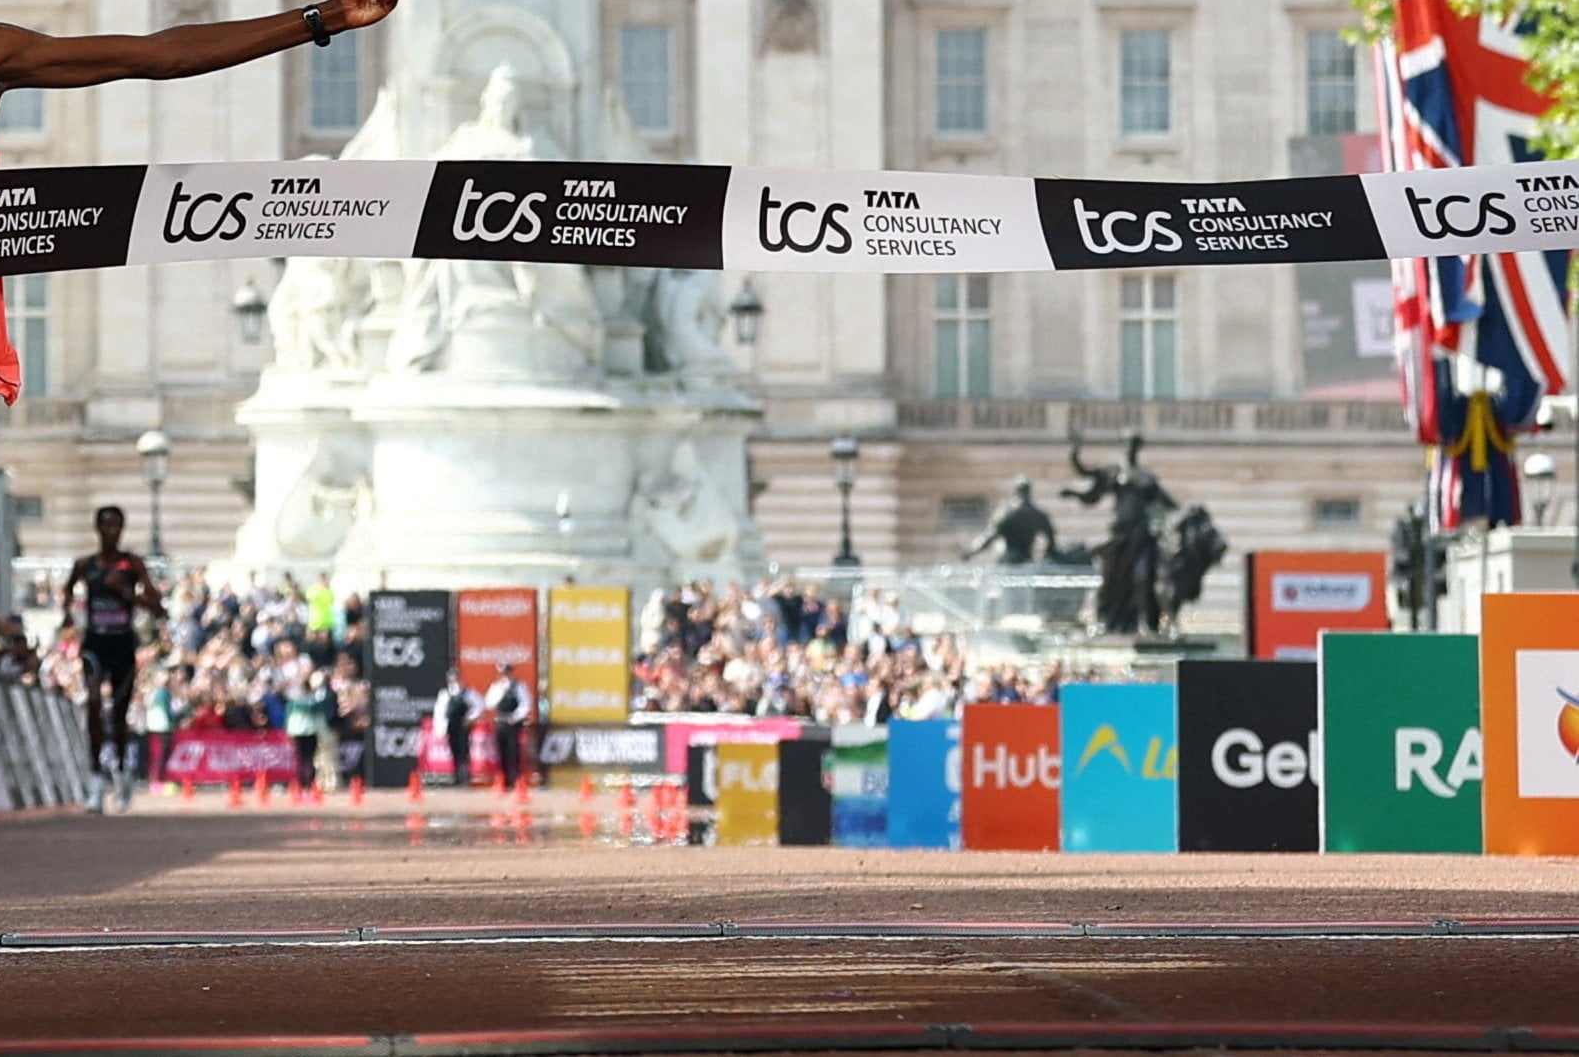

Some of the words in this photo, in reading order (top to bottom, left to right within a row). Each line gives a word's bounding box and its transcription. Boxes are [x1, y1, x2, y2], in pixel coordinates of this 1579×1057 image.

[269, 177, 321, 196] TATA
[562, 179, 617, 199] TATA
[1515, 174, 1579, 193] TATA
[260, 196, 391, 219] CONSULTANCY
[451, 177, 548, 243] tcs
[863, 189, 921, 210] TATA
[1180, 196, 1247, 214] TATA
[162, 180, 255, 244] tcs
[554, 201, 689, 226] CONSULTANCY
[758, 185, 853, 255] tcs
[1188, 211, 1334, 234] CONSULTANCY
[1405, 186, 1517, 239] tcs
[253, 221, 336, 240] SERVICES
[862, 213, 1003, 237] CONSULTANCY
[1073, 196, 1183, 256] tcs
[549, 226, 637, 248] SERVICES
[865, 238, 957, 258] SERVICES
[1194, 233, 1290, 253] SERVICES
[372, 632, 426, 668] tcs
